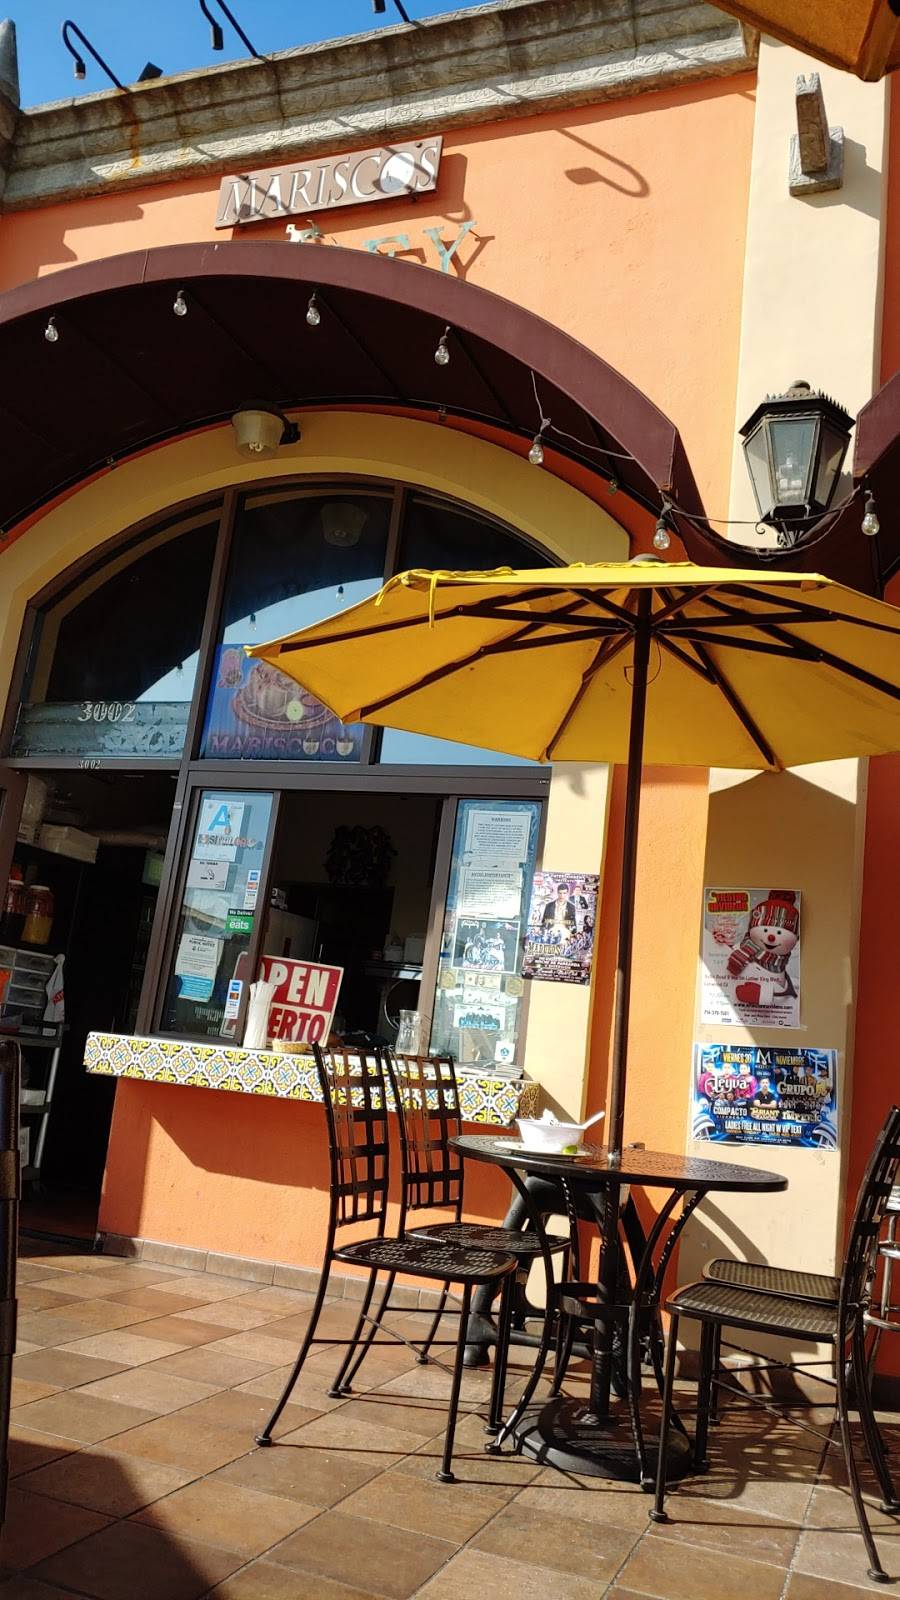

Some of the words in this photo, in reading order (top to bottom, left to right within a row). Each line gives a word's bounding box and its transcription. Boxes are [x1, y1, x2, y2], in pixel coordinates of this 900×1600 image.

[219, 145, 438, 223] MARISCOS
[78, 701, 137, 722] 3002
[79, 759, 102, 770] 3002
[229, 921, 249, 930] eats
[260, 961, 330, 1007] PEN
[777, 1081, 814, 1096] GRUPO
[713, 1106, 747, 1117] COMPACTO
